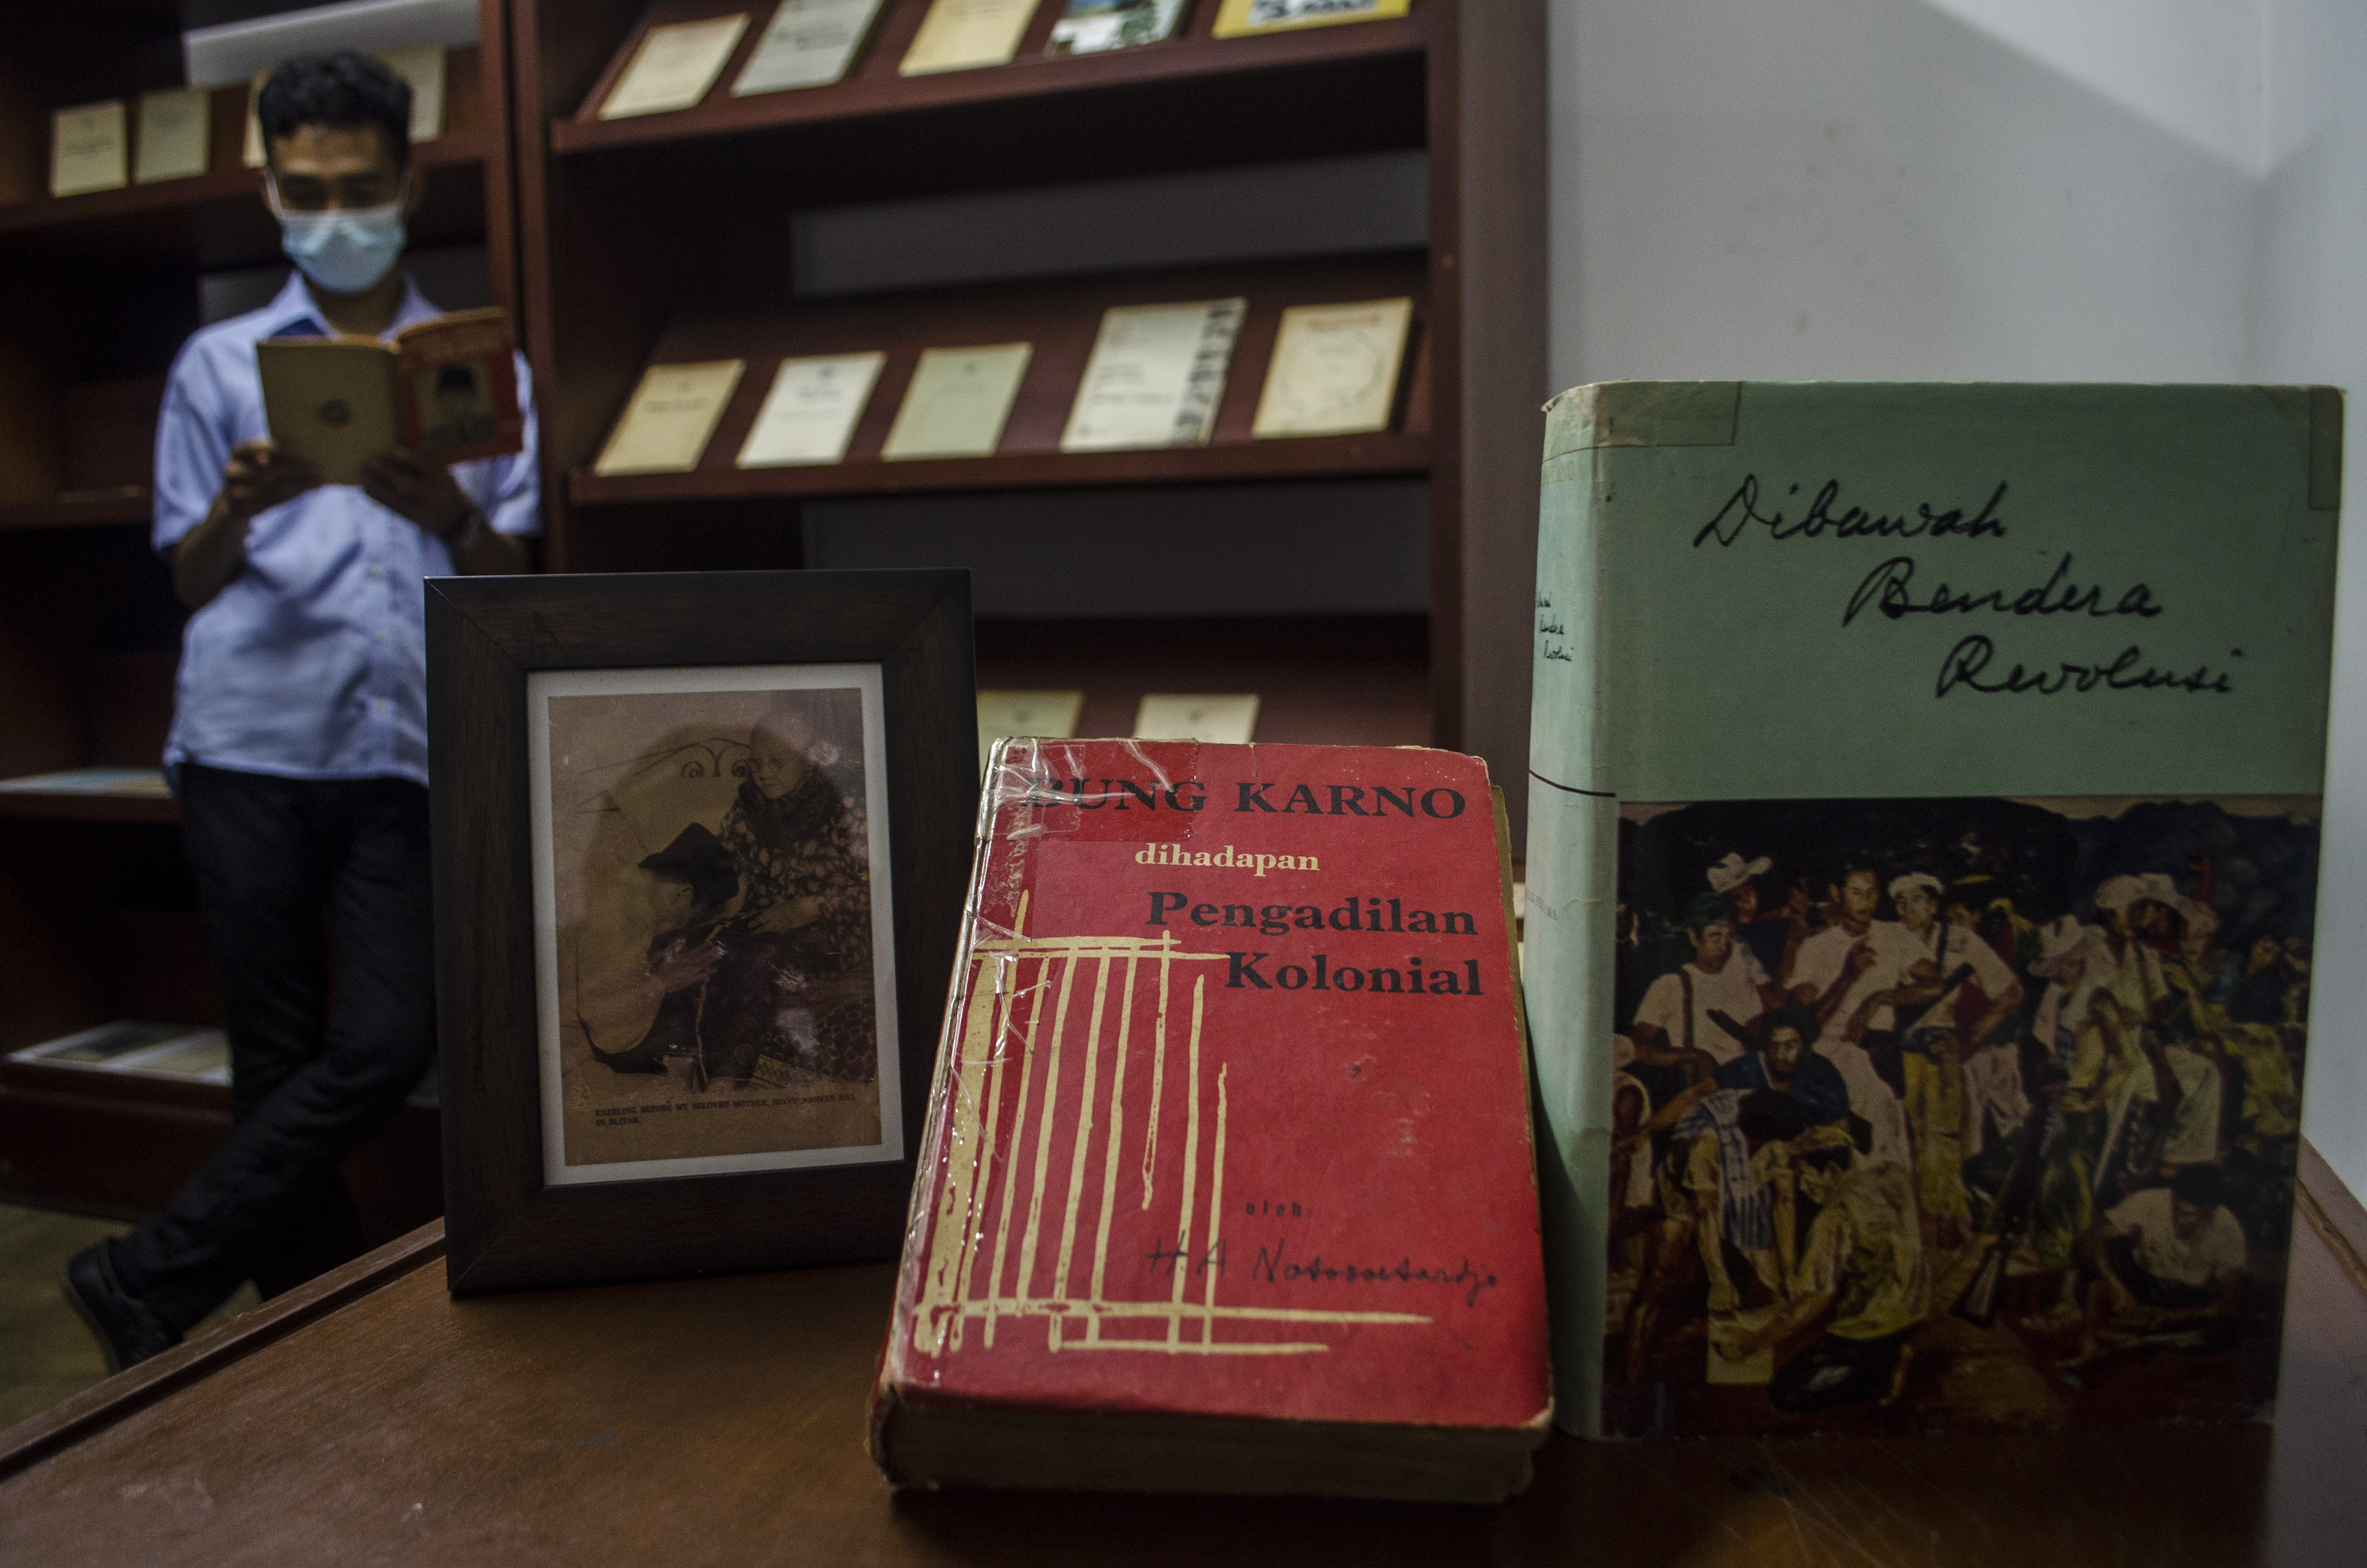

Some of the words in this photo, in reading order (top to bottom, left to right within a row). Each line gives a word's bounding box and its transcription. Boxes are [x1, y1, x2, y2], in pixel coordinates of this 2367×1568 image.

[1692, 473, 2009, 547] Dibawah
[1842, 552, 2163, 627] Bendera
[1023, 777, 1207, 812] BUNG
[1233, 782, 1466, 819] KARNO
[1134, 843, 1320, 877] dihadapan
[1145, 891, 1479, 936] Pengadilan
[1224, 951, 1484, 996] Kolonial
[595, 1106, 637, 1117] KNEELING
[640, 1104, 672, 1114] BEFORE
[692, 1101, 729, 1109] BELOVED
